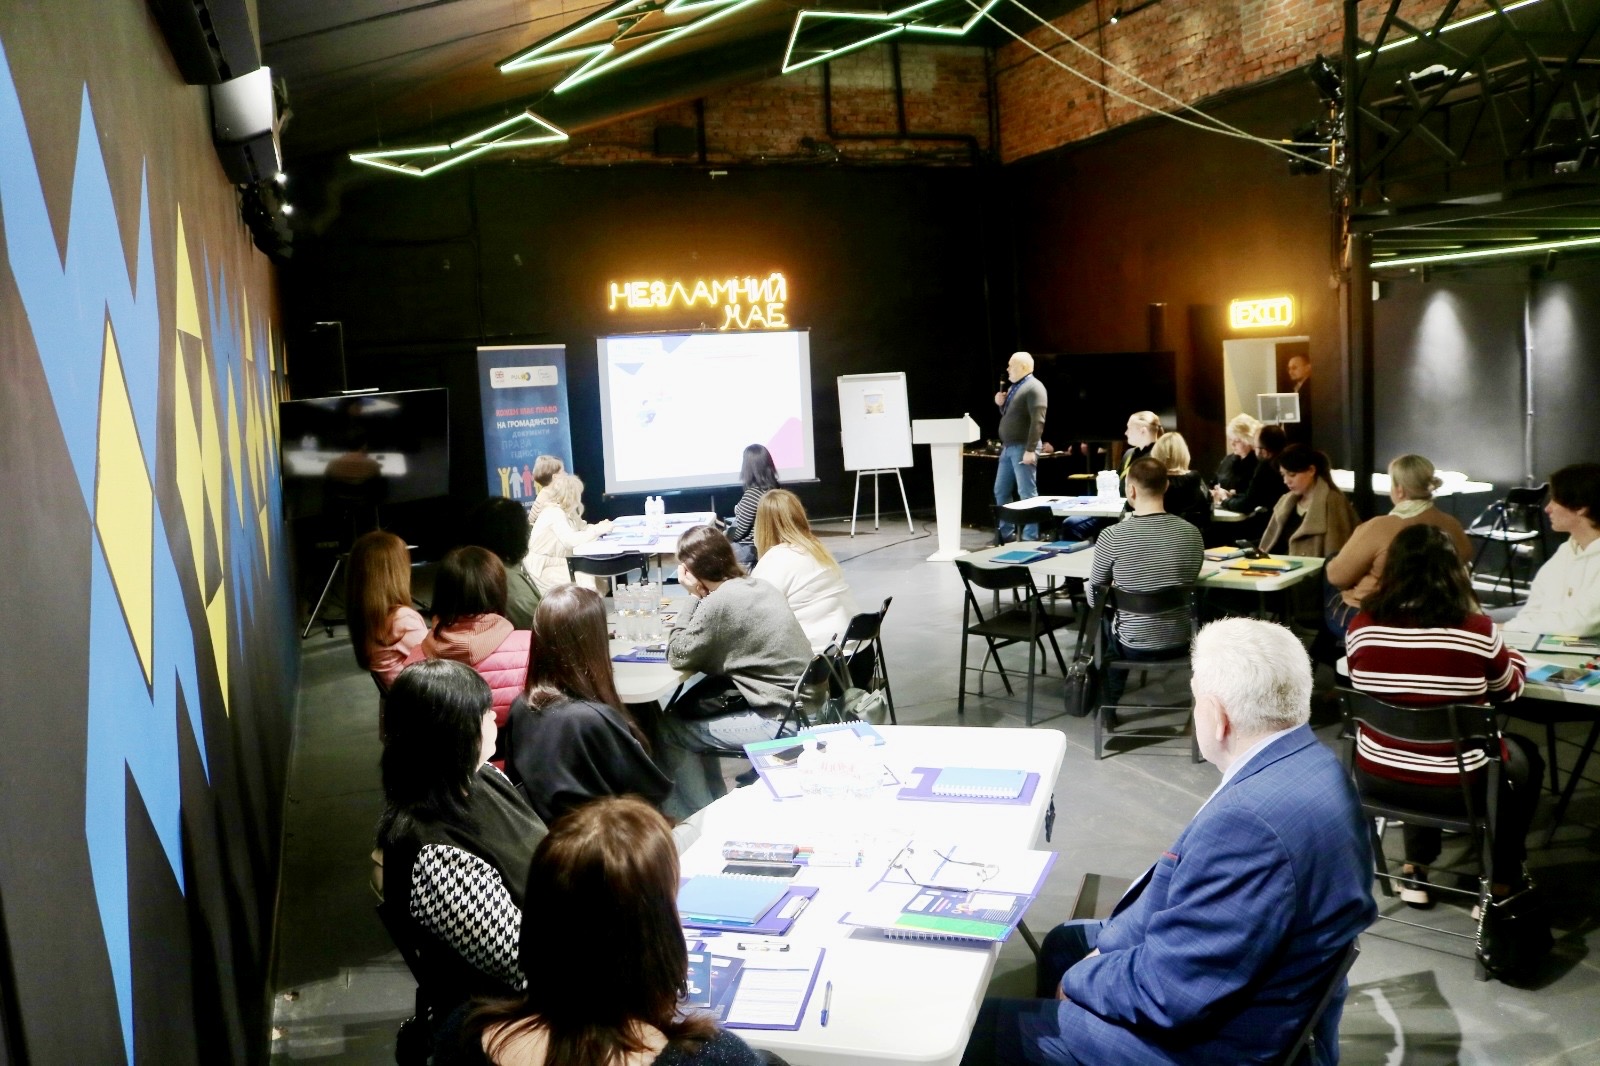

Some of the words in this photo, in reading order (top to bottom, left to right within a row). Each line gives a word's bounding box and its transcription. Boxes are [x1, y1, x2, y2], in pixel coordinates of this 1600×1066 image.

[609, 272, 787, 310] НЕЗЛАМНИЙ
[1235, 300, 1291, 325] EXIT
[535, 405, 558, 414] ПРАВО
[496, 421, 506, 429] НА
[507, 416, 559, 428] ГРОМАДЯНСТВО
[512, 429, 550, 438] ДОКУМЕНТИ
